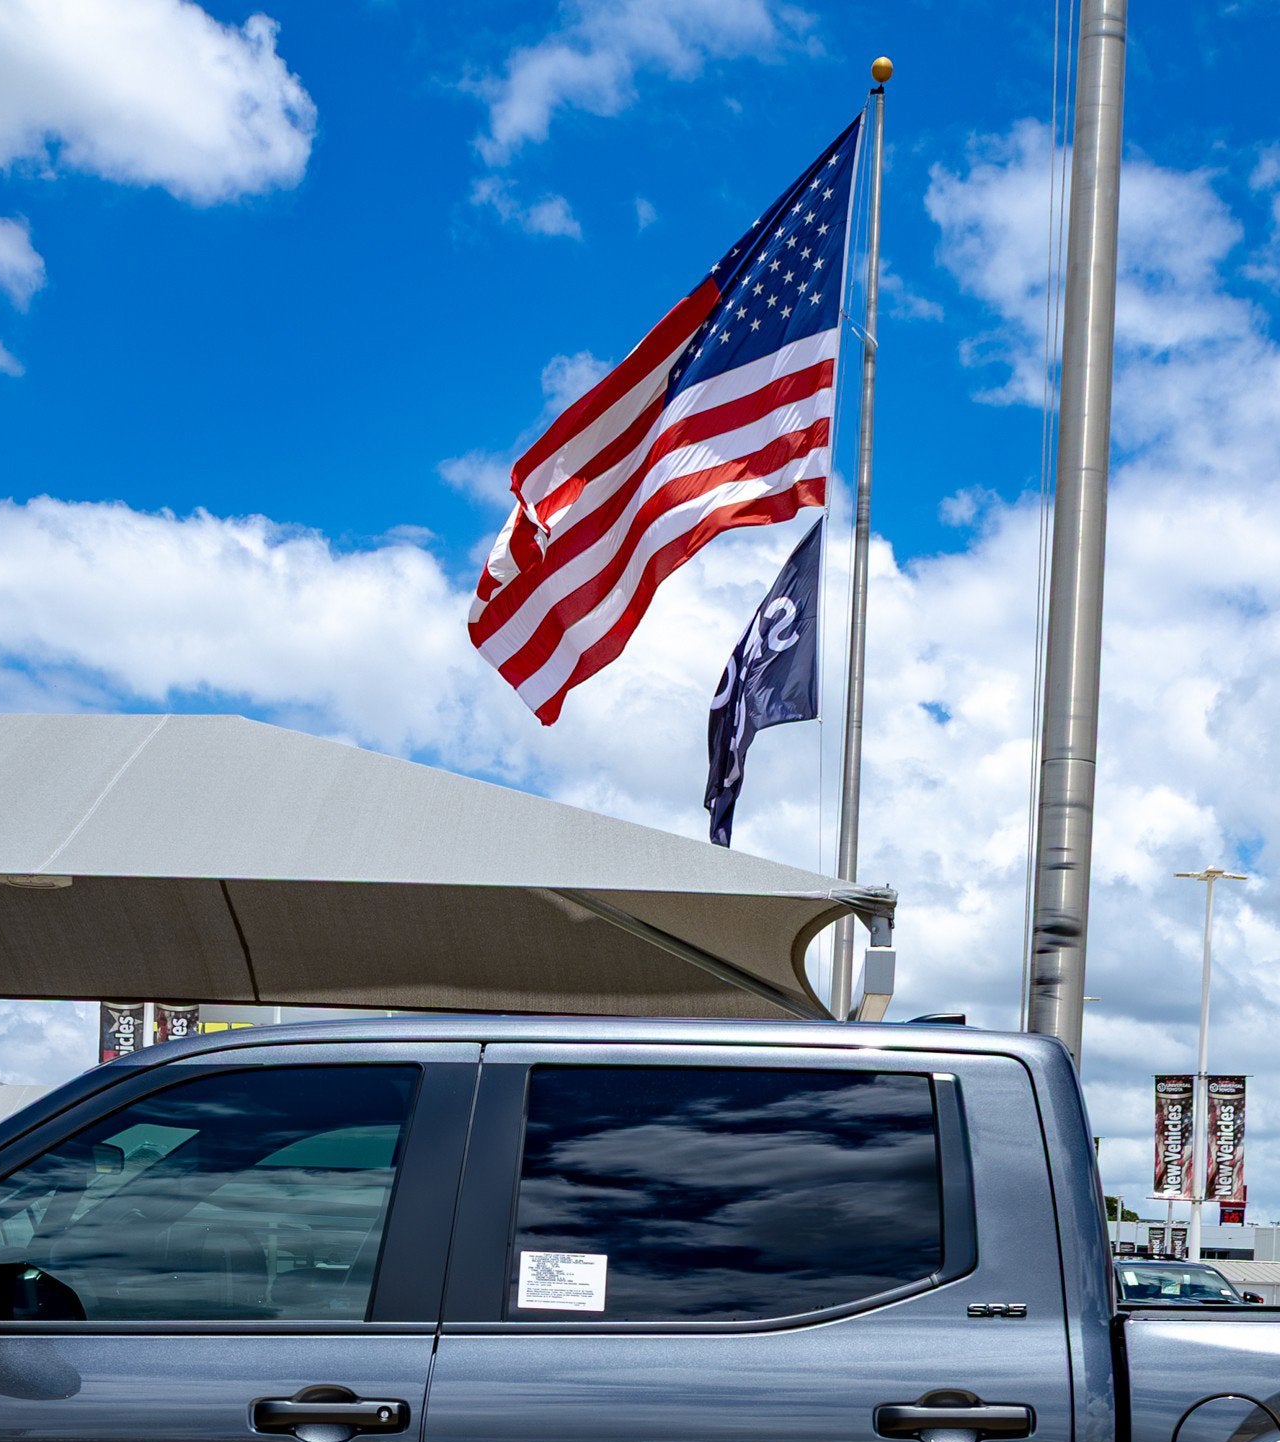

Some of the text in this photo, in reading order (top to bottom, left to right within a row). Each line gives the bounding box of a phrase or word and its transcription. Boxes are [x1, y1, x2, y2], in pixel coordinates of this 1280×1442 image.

[1163, 1104, 1182, 1162] Vehicles
[1217, 1105, 1235, 1163] Vehicles
[1164, 1162, 1182, 1195] New
[1215, 1163, 1233, 1196] New
